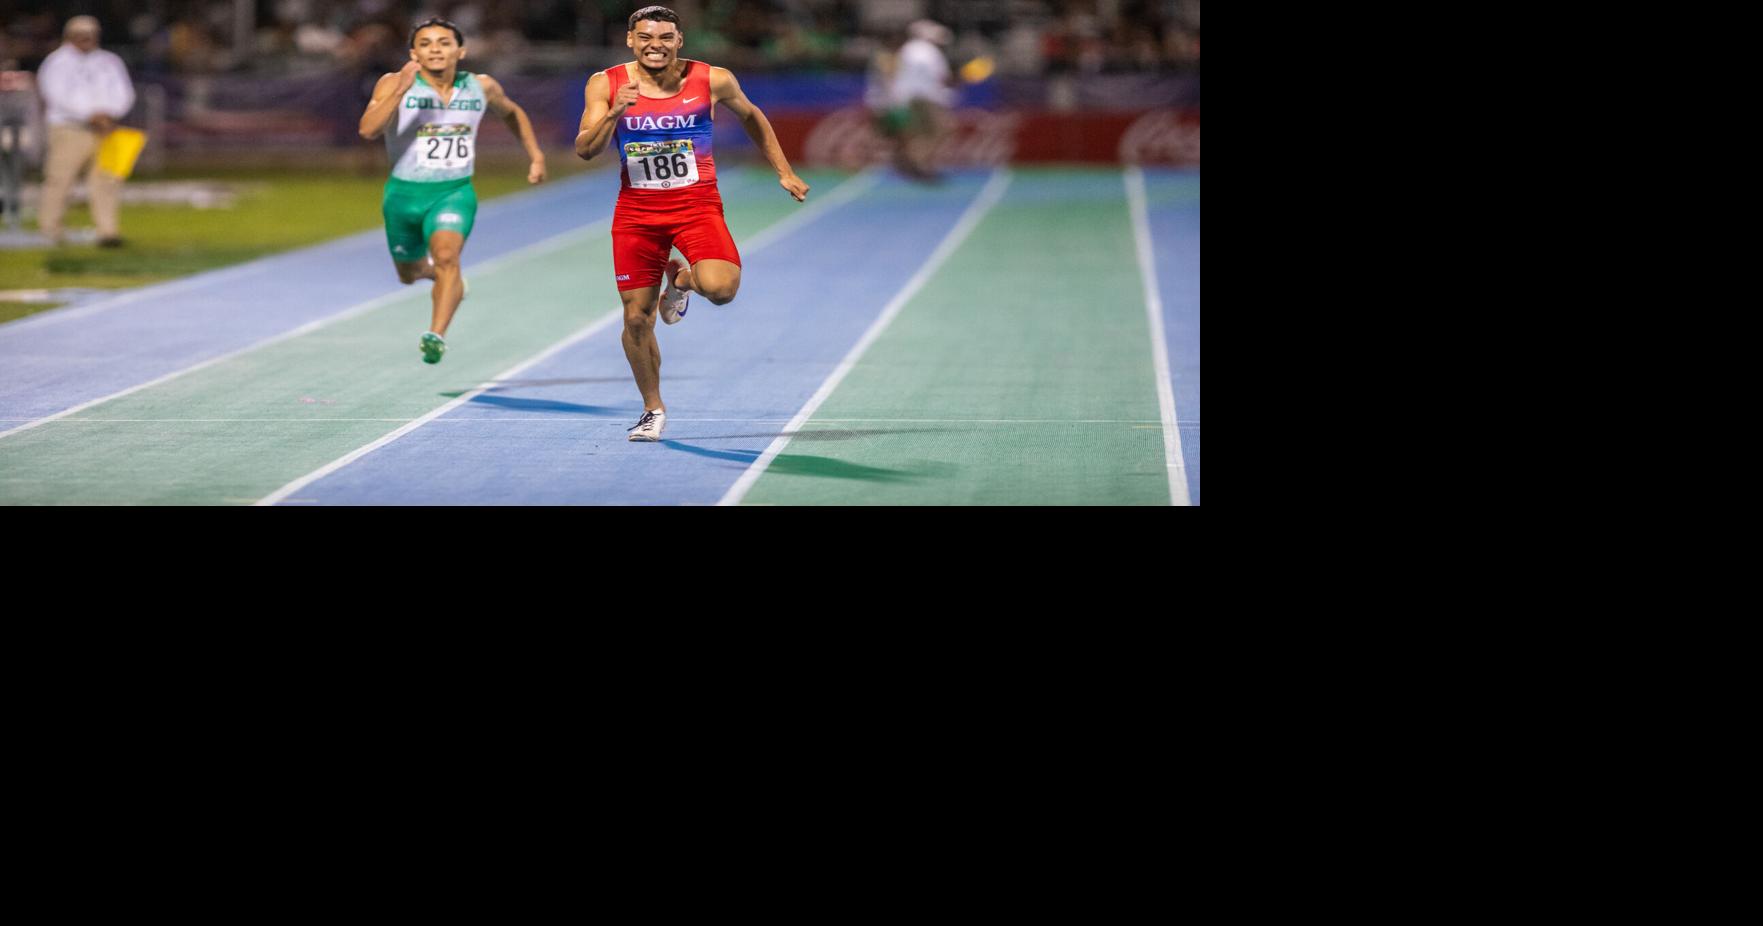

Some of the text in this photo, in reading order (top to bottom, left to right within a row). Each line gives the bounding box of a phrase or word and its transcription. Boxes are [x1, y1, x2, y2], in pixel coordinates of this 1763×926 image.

[623, 114, 697, 131] UAGM
[427, 137, 468, 159] 276
[637, 153, 689, 181] 186
